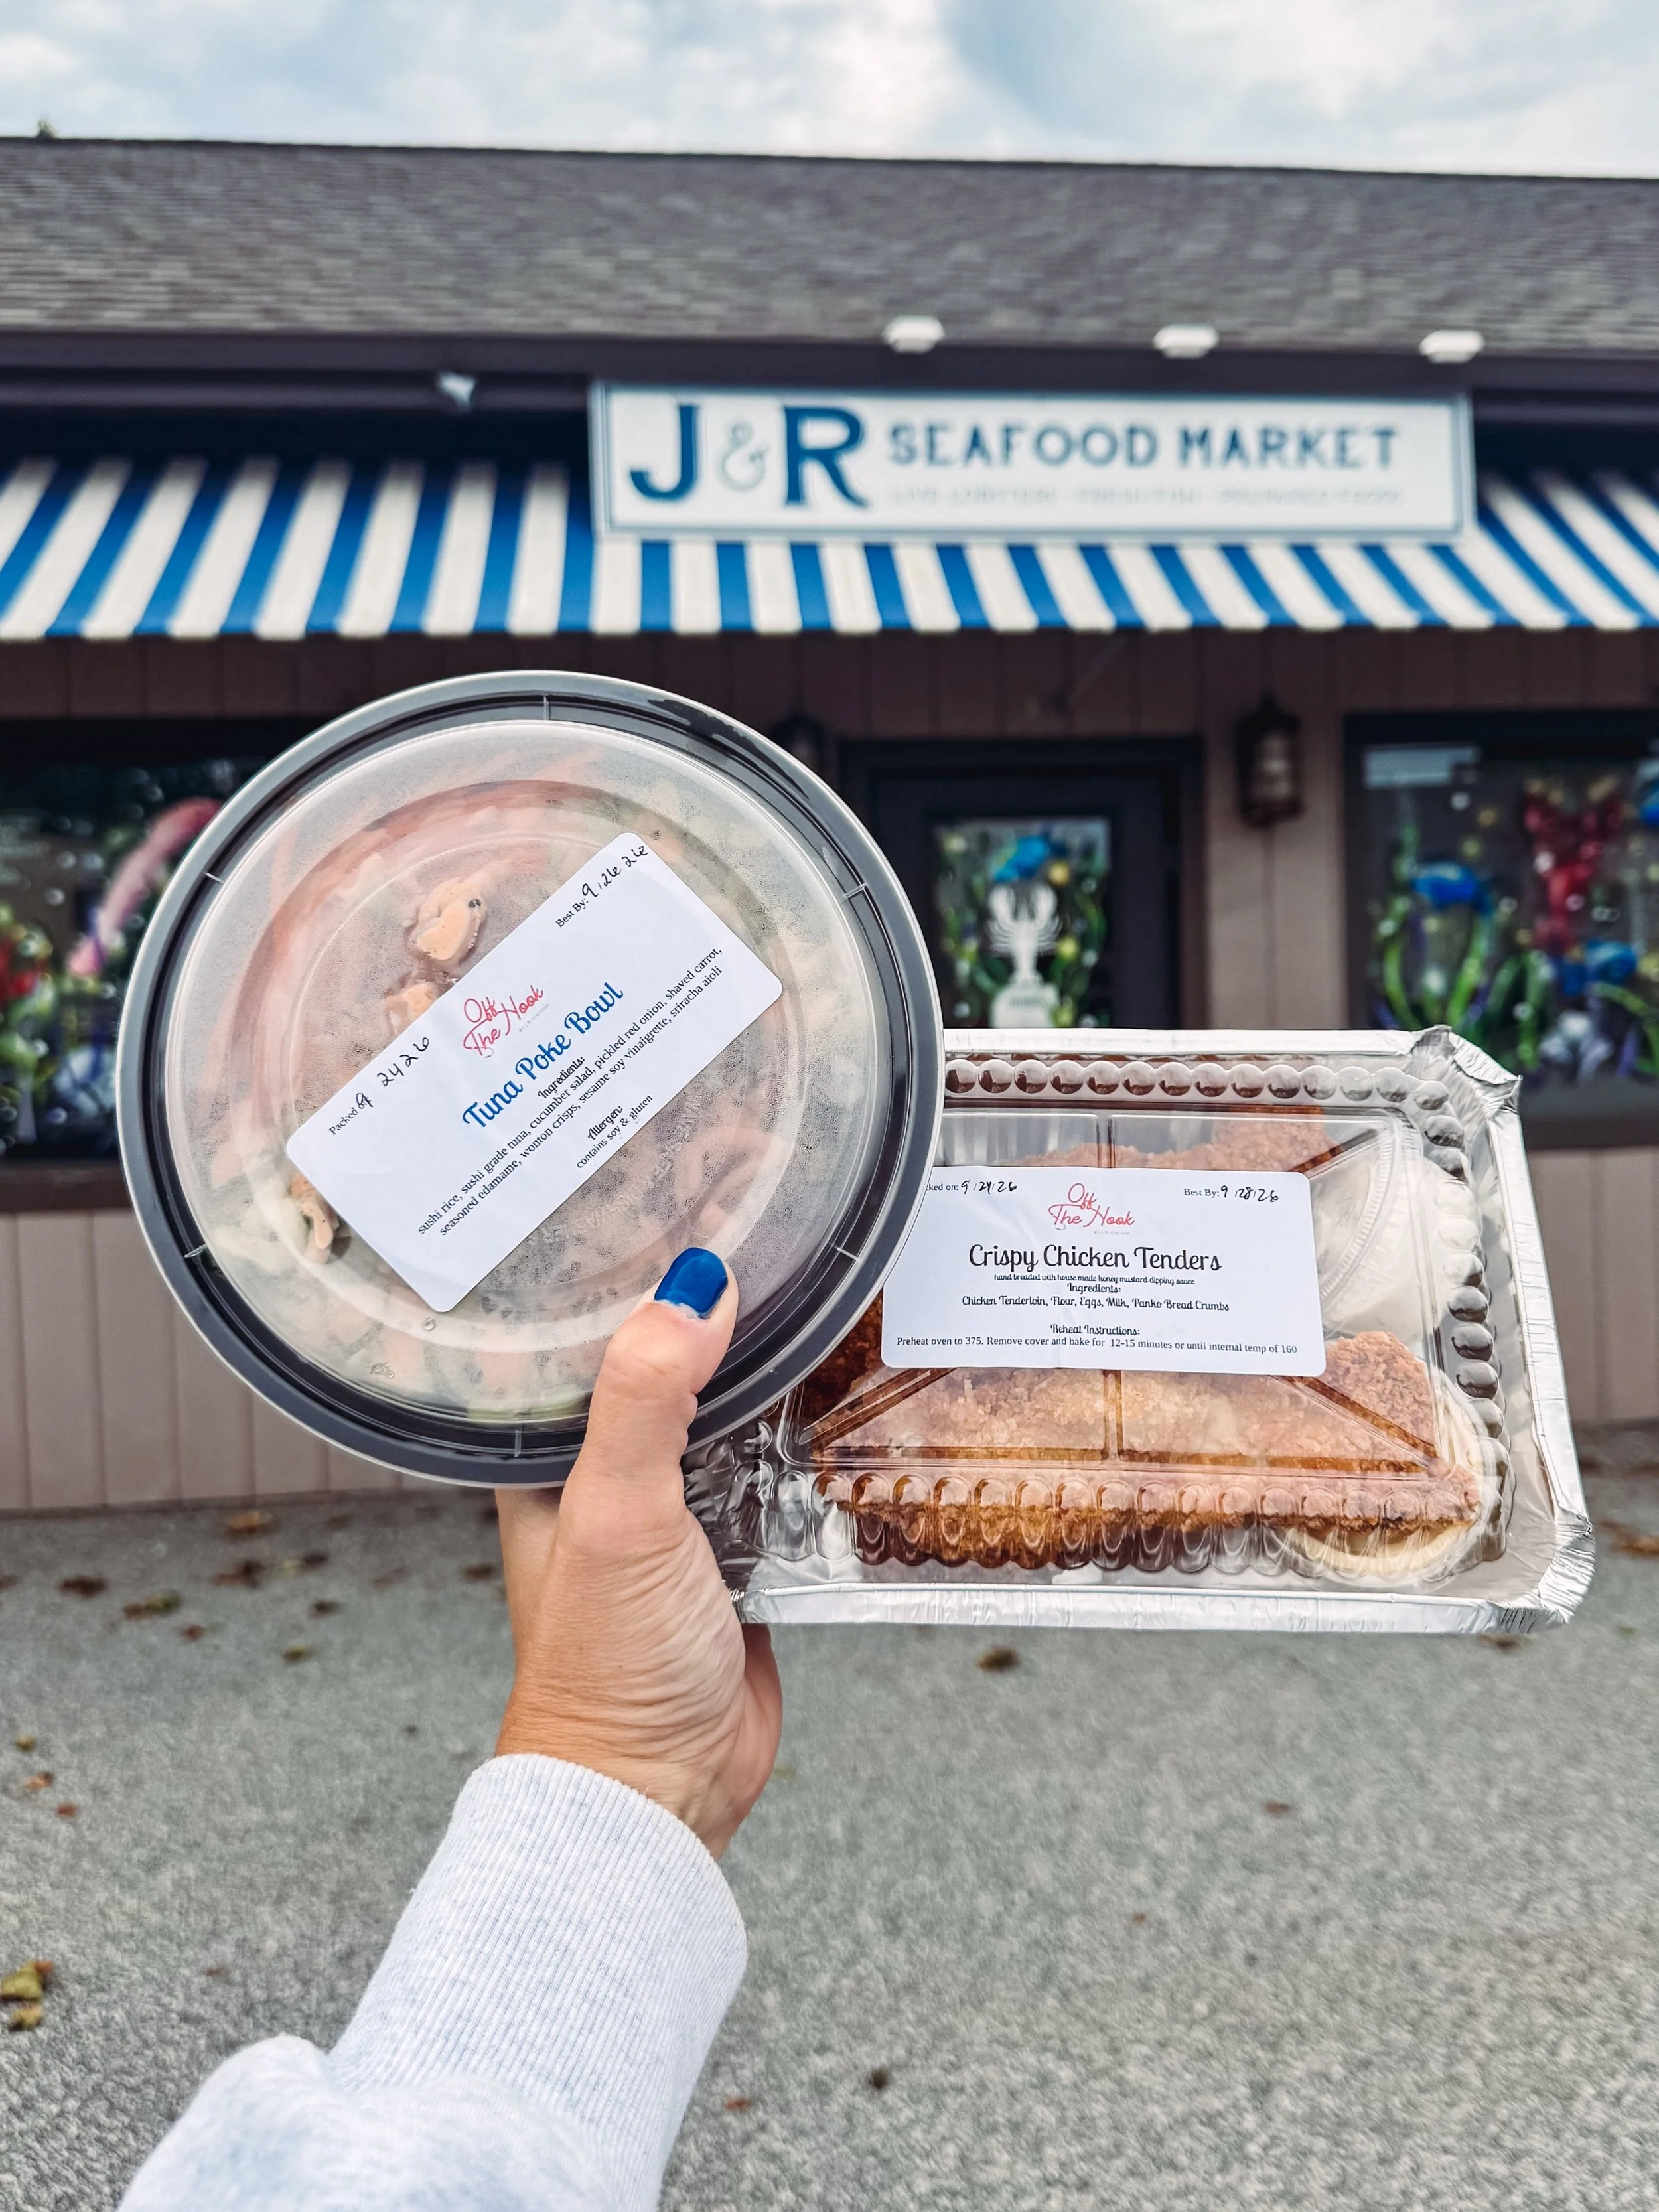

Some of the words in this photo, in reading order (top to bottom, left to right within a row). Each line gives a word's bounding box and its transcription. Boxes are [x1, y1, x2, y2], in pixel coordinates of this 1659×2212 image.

[889, 422, 1160, 469] SEAFOOD
[1176, 425, 1400, 470] MARKET
[554, 910, 575, 928] Best
[571, 897, 589, 913] By:
[462, 1017, 507, 1056] The
[497, 984, 543, 1036] Hook
[463, 996, 502, 1023] Off
[461, 1079, 524, 1128] Tuna
[514, 1033, 571, 1080] Poke
[563, 981, 624, 1035] Bowl
[417, 1209, 443, 1234] sushi
[440, 1194, 463, 1213] rice,
[460, 1169, 485, 1195] sushi
[483, 1147, 509, 1174] grade
[506, 1130, 532, 1149] tuna,
[529, 1088, 571, 1129] cucumber
[569, 1066, 597, 1091] salad,
[593, 1035, 626, 1070] pickled
[623, 1021, 641, 1039] red
[638, 1001, 668, 1025] onion,
[664, 970, 696, 1001] shaved
[693, 948, 723, 973] carrot,
[536, 1056, 585, 1098] Ingredients:
[439, 1195, 480, 1236] seasoned
[477, 1159, 522, 1199] edamame,
[519, 1127, 553, 1158] wonton
[551, 1104, 581, 1129] crisps,
[578, 1072, 611, 1104] sesame
[608, 1057, 626, 1075] soy
[623, 1017, 672, 1059] vinaigrette,
[669, 984, 704, 1017] sriracha
[701, 965, 723, 987] aioli
[328, 1106, 359, 1136] Packed
[576, 1138, 608, 1169] contains
[606, 1124, 621, 1140] soy
[618, 1117, 630, 1127] &
[628, 1095, 653, 1120] gluten
[587, 1105, 623, 1140] Allergen:
[926, 1181, 944, 1191] ked
[1068, 1183, 1097, 1210] Off
[1183, 1187, 1202, 1196] Best
[1203, 1188, 1220, 1199] By:
[1048, 1203, 1083, 1225] The
[1083, 1205, 1135, 1227] Hook
[968, 1243, 1039, 1273] Crispy
[1043, 1244, 1130, 1268] Chicken
[1133, 1246, 1223, 1271] Tenders
[1012, 1272, 1041, 1281] breaded
[1097, 1274, 1118, 1284] honey
[1148, 1276, 1175, 1286] dipping
[1066, 1282, 1121, 1295] Ingredients:
[961, 1295, 997, 1306] Chicken
[997, 1294, 1048, 1307] Tenderloin,
[1050, 1295, 1077, 1307] Flour,
[1079, 1295, 1104, 1309] Eggs,
[1105, 1296, 1129, 1309] Milk,
[1131, 1297, 1163, 1309] Panko
[1163, 1299, 1194, 1310] Bread
[1194, 1299, 1230, 1311] Crumbs
[1049, 1323, 1083, 1334] Reheat
[1083, 1323, 1141, 1336] Instructions:
[897, 1336, 929, 1345] Preheat
[964, 1335, 984, 1345] 375.
[986, 1336, 1023, 1345] Remove
[1050, 1336, 1067, 1345] and
[1068, 1336, 1090, 1346] bake
[1091, 1337, 1105, 1347] for
[1110, 1338, 1135, 1347] 12-15
[1137, 1339, 1173, 1349] minutes
[1185, 1341, 1206, 1350] until
[1208, 1341, 1242, 1352] internal
[1244, 1344, 1267, 1355] temp
[1268, 1343, 1279, 1353] of
[1281, 1345, 1297, 1354] 160
